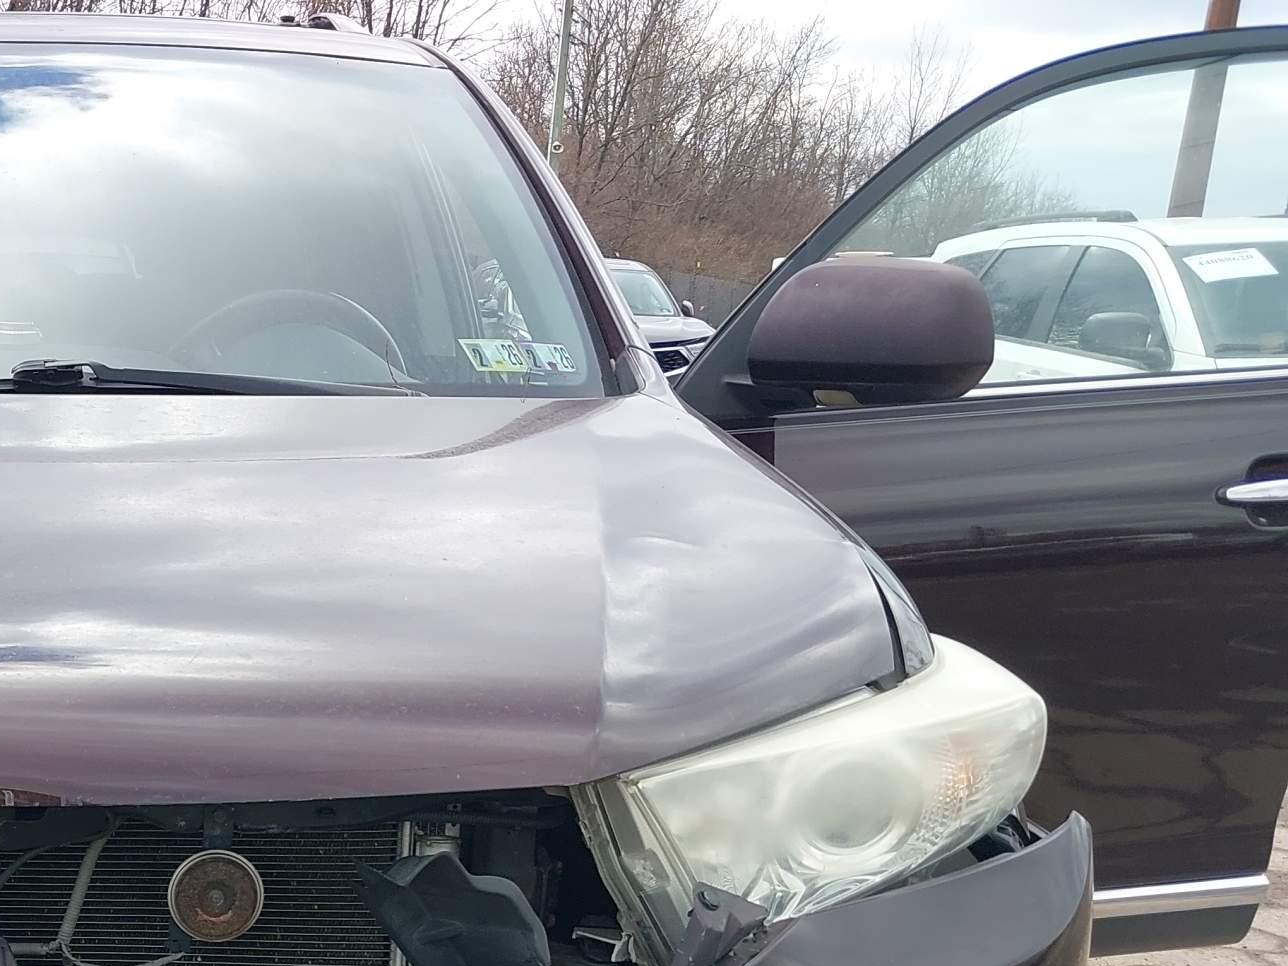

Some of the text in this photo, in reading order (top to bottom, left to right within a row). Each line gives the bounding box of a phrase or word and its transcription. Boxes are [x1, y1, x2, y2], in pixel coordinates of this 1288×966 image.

[472, 343, 524, 367] 2 26
[525, 346, 575, 369] 2 26
